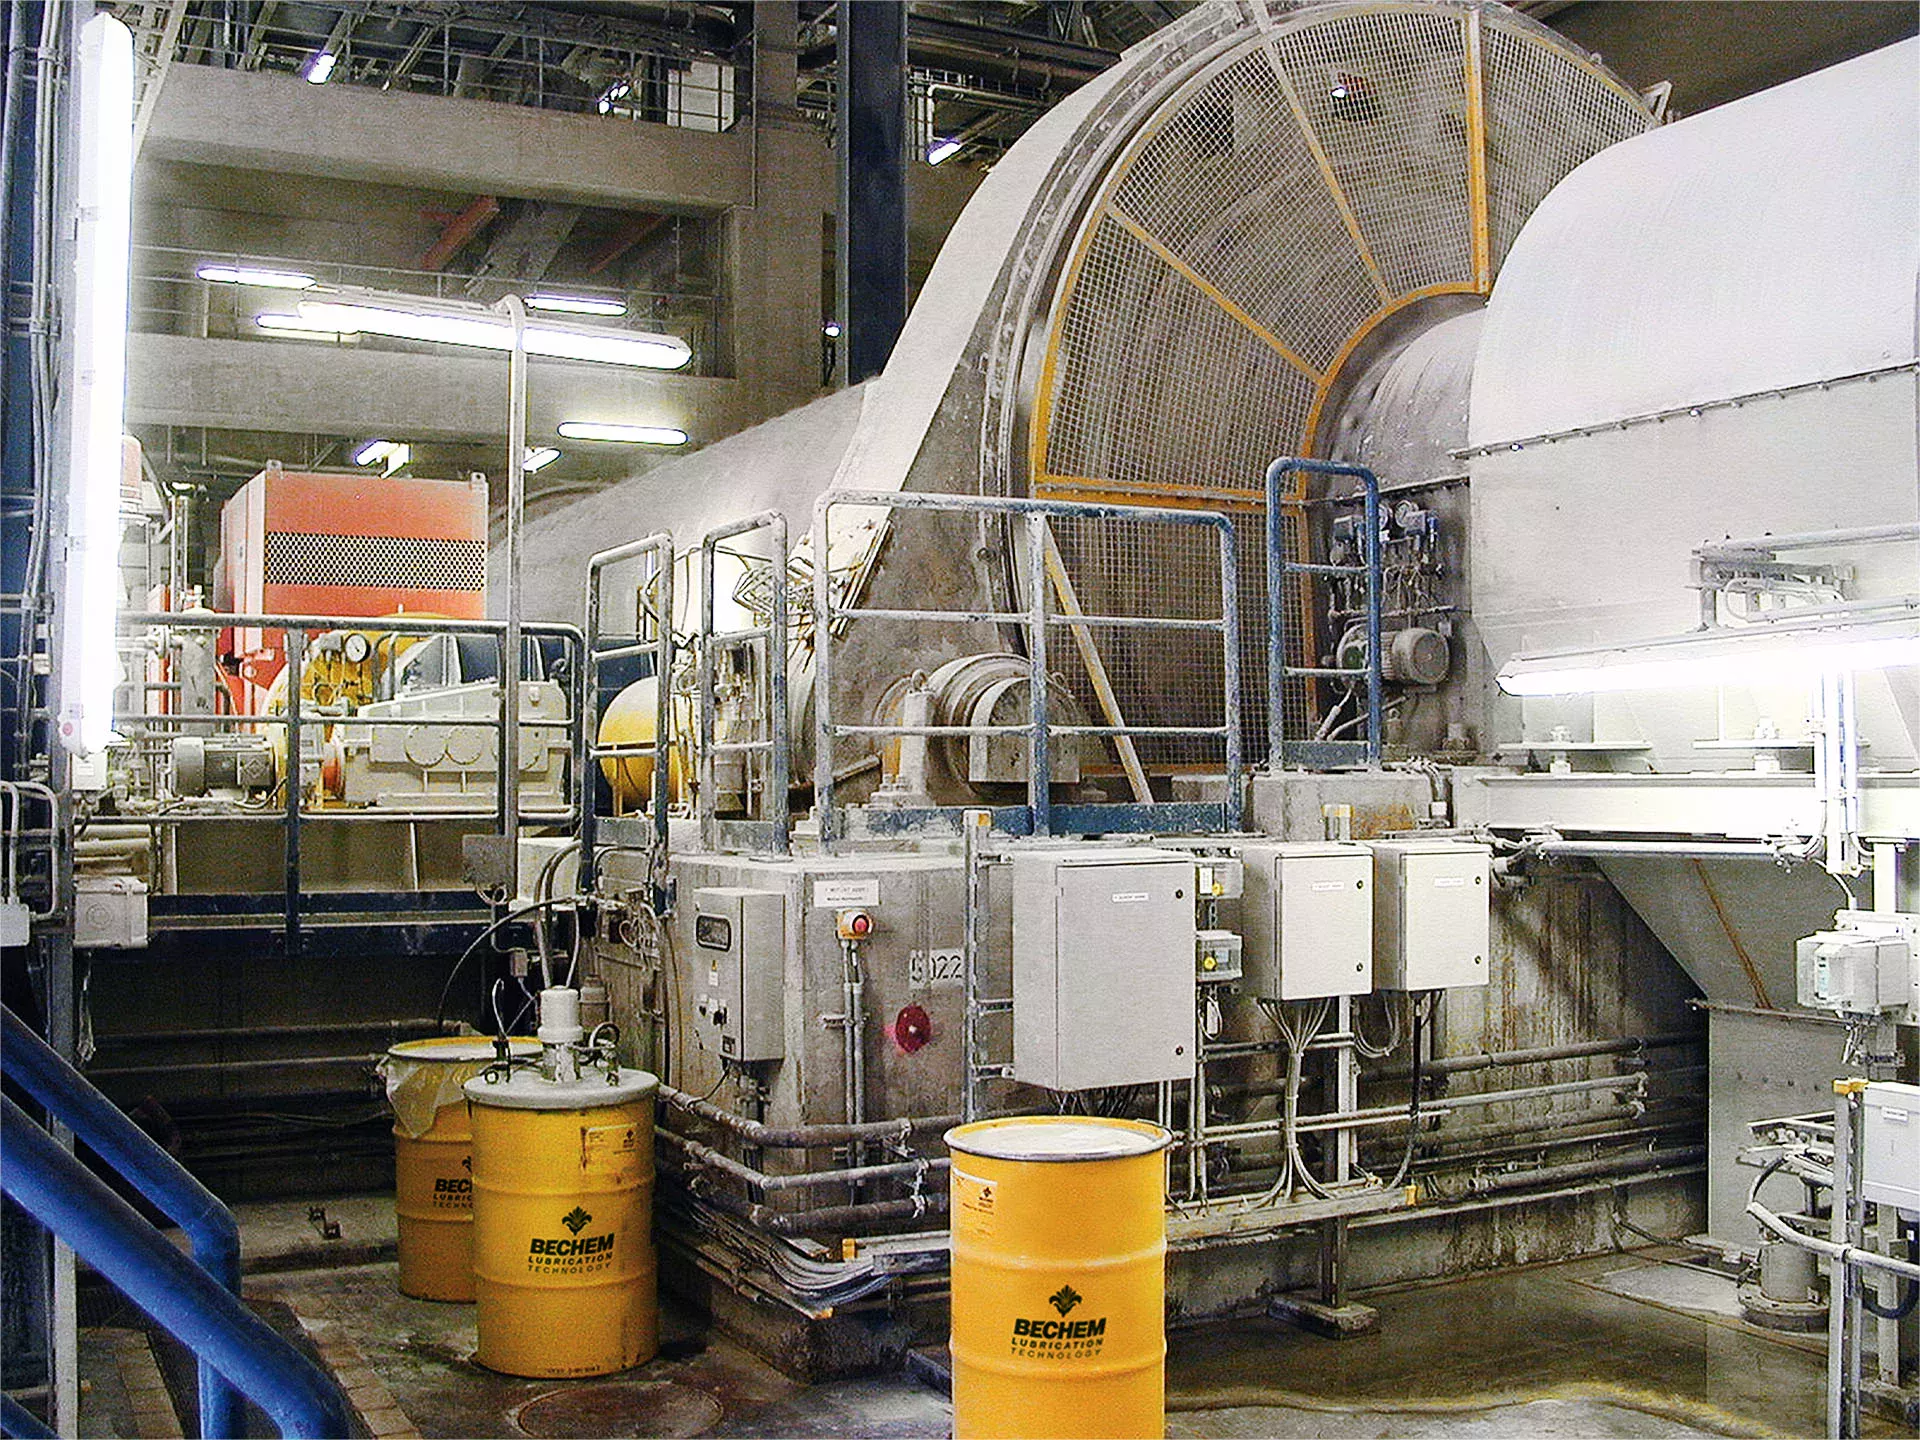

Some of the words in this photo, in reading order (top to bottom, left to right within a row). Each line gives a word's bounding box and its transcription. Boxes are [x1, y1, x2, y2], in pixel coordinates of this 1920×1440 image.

[530, 1233, 615, 1256] BECHEM
[528, 1252, 613, 1266] LUBRICATION
[528, 1262, 610, 1275] TECHNOLOGY
[1014, 1317, 1107, 1339] BECHEM
[1011, 1337, 1104, 1350] LUBRICATION
[1010, 1347, 1102, 1360] TECHNOLOGY
